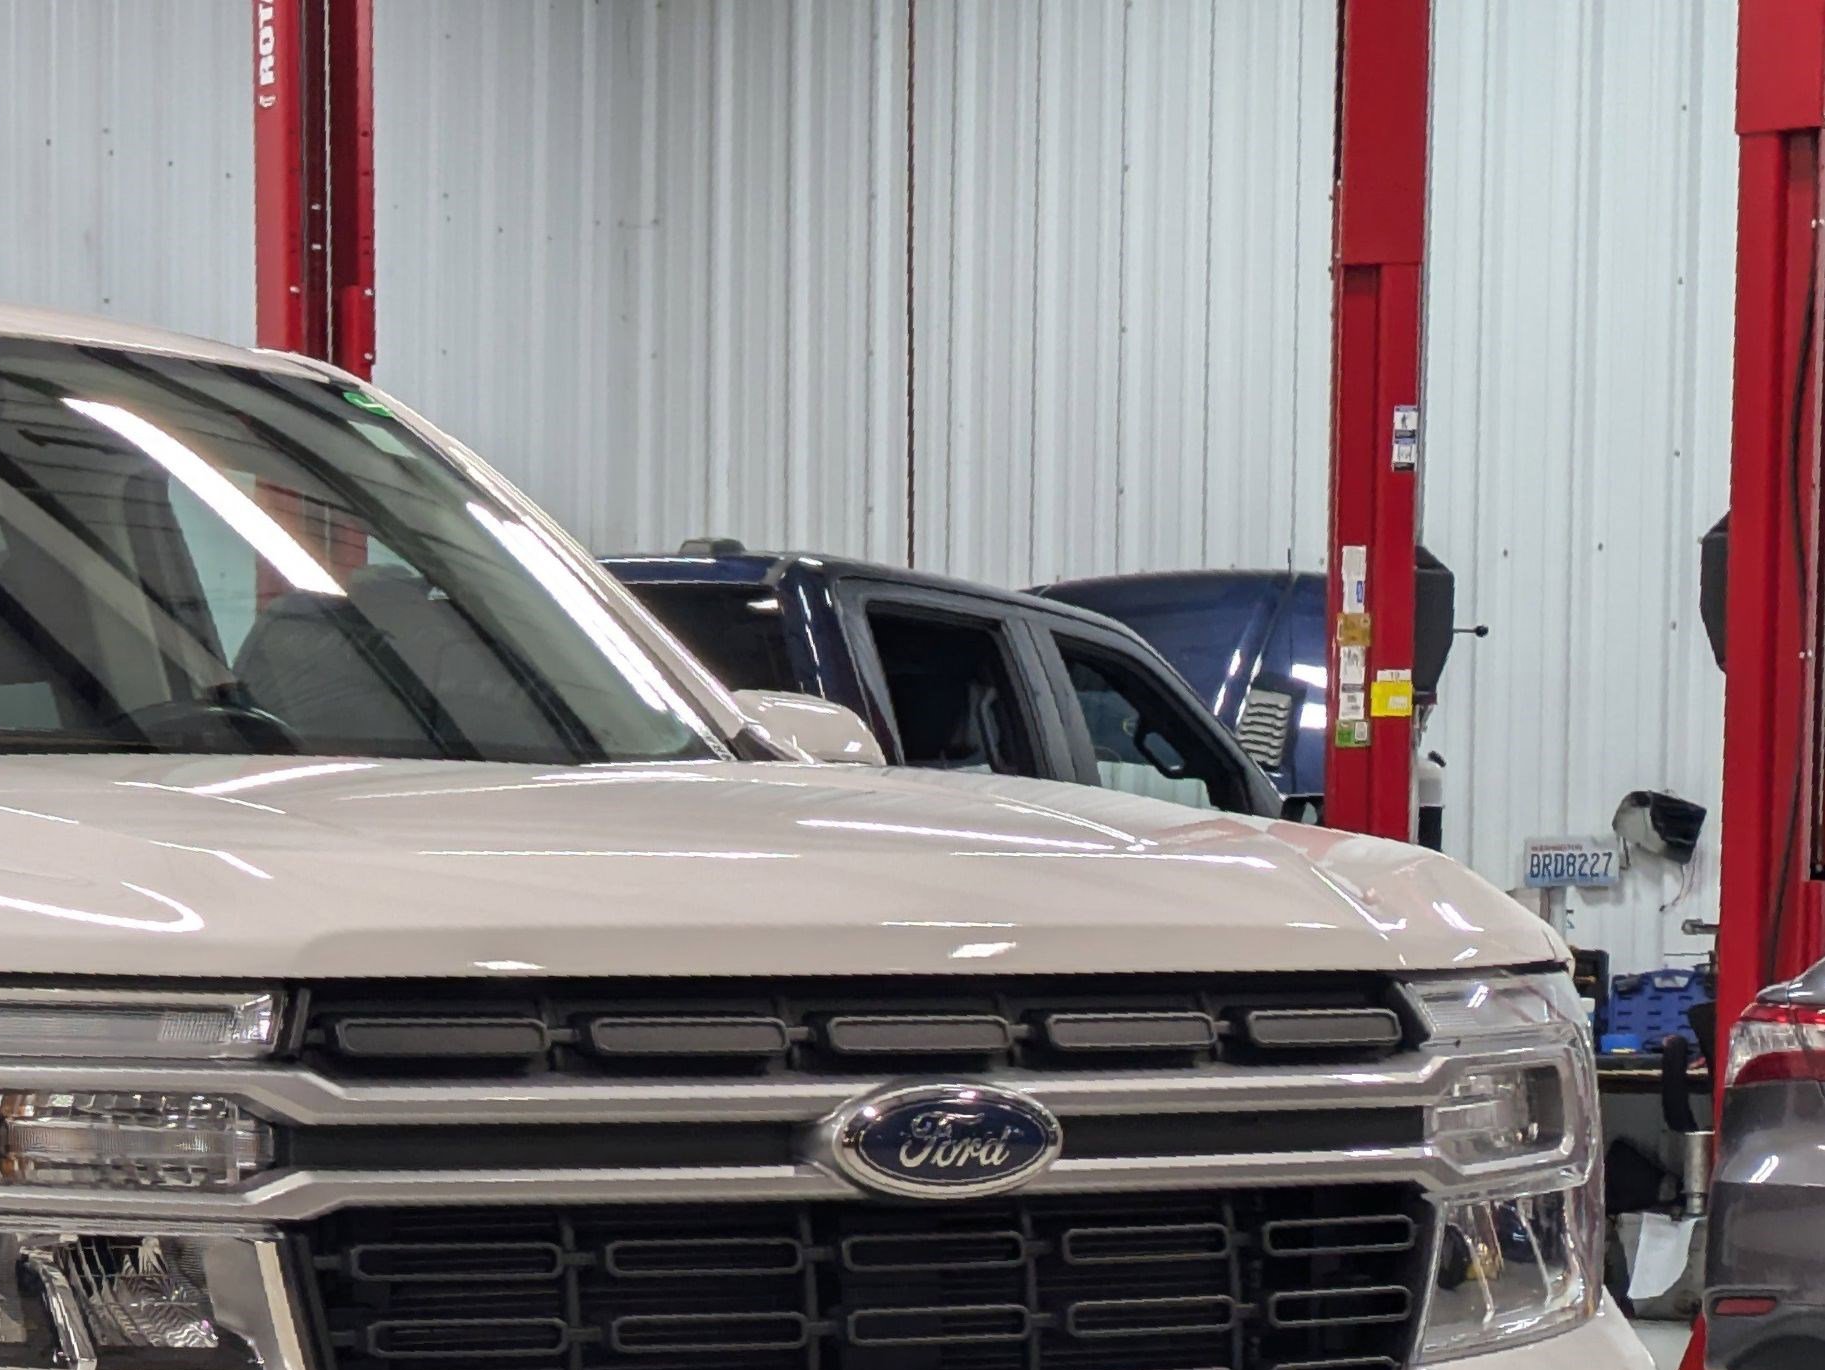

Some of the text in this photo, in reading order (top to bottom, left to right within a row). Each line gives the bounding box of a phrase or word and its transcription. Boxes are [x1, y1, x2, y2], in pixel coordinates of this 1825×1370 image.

[258, 0, 275, 86] ROT
[1529, 851, 1613, 878] BRD8227
[899, 1111, 1024, 1168] Ford
